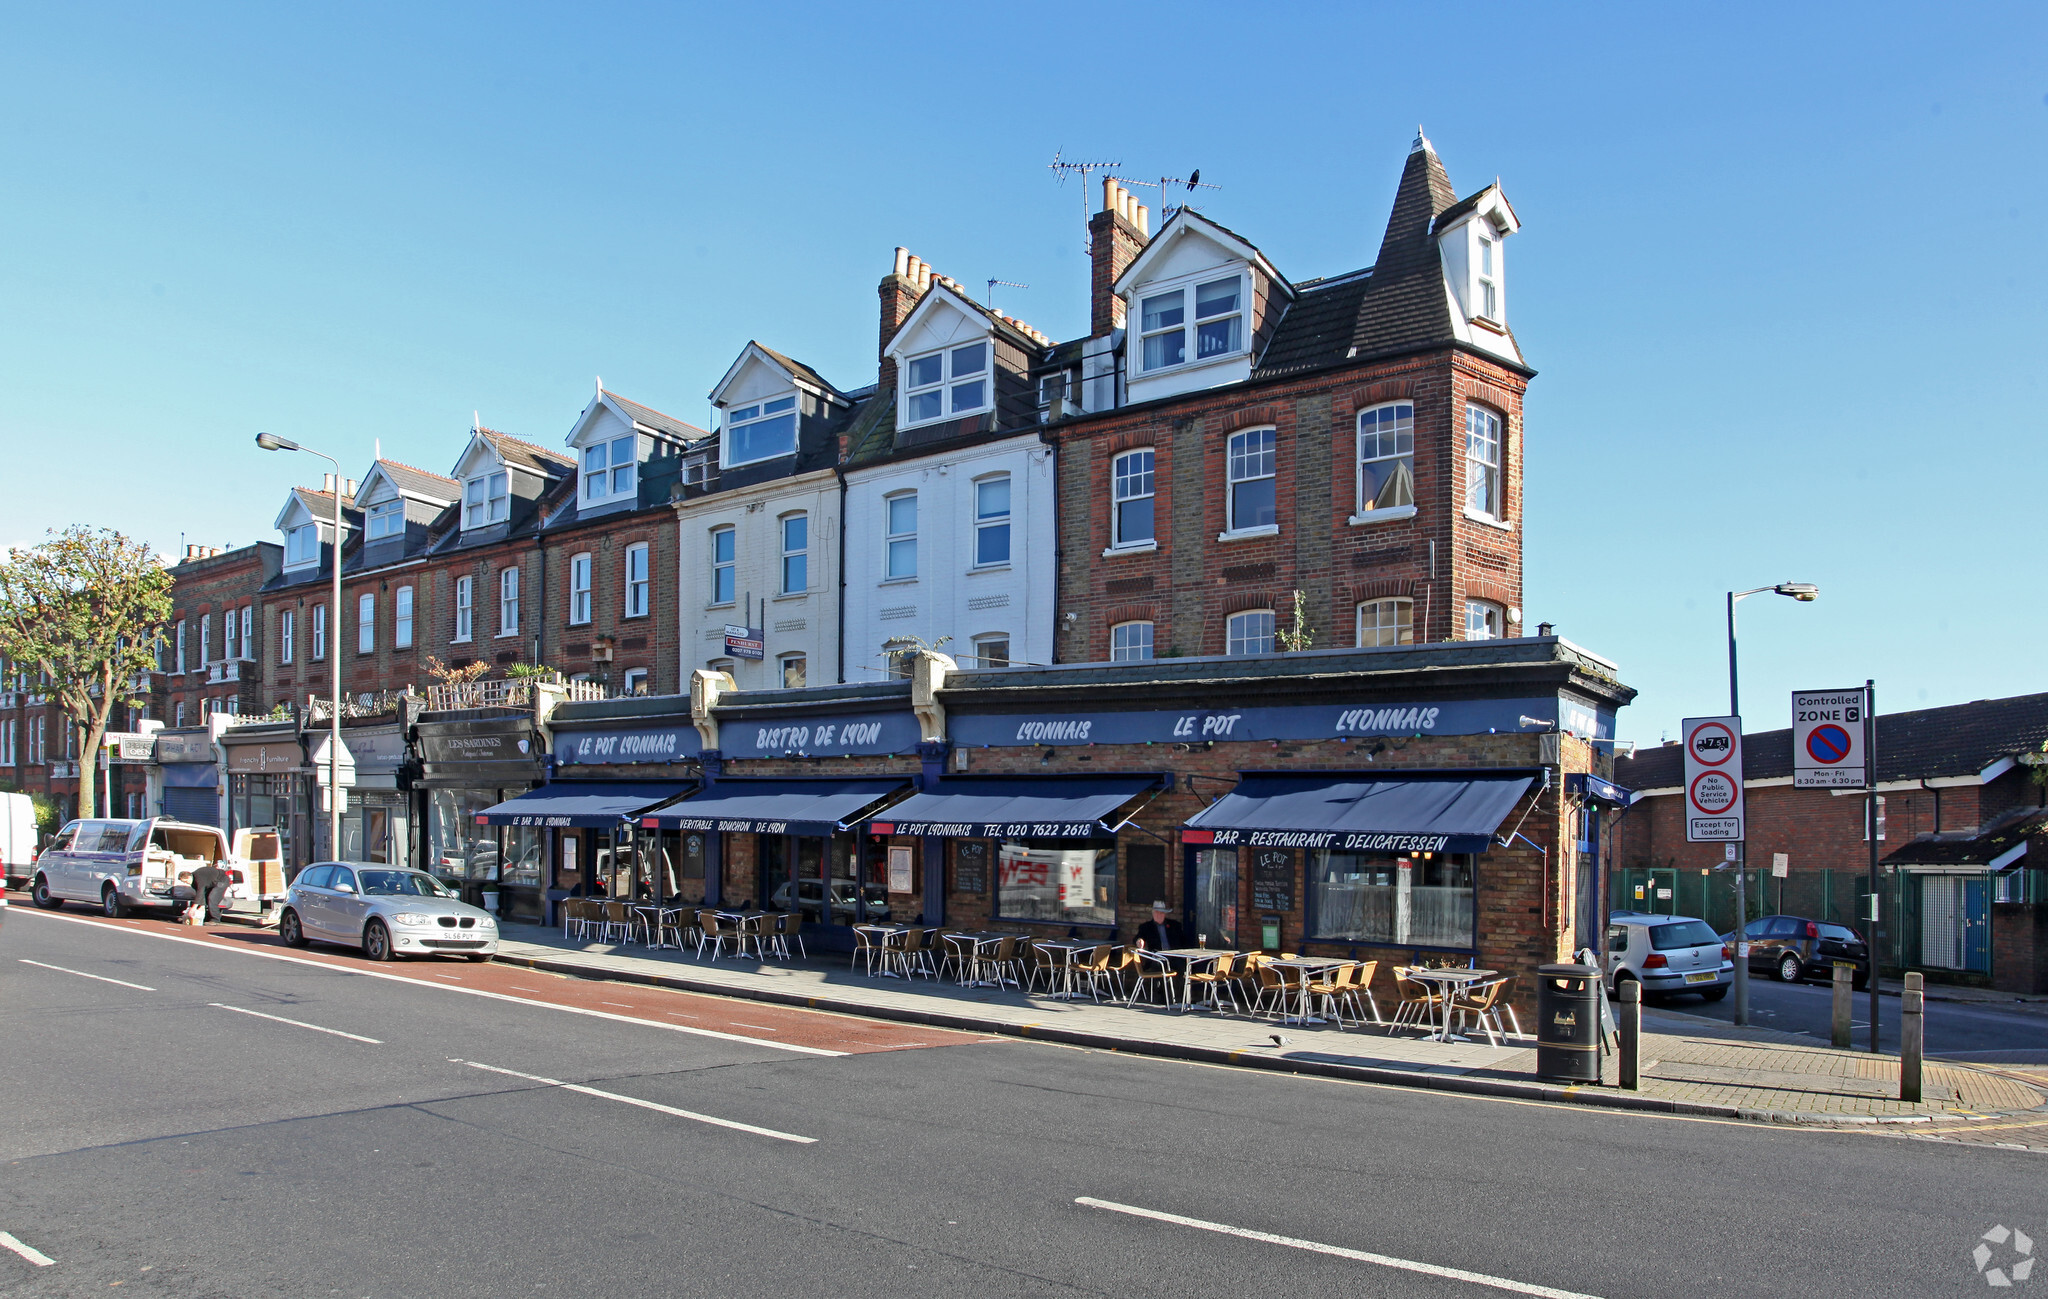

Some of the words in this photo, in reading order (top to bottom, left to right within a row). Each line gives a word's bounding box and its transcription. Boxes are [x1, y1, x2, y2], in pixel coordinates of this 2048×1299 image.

[730, 640, 758, 648] PENHURST
[1798, 695, 1858, 706] Controlled
[1336, 707, 1440, 731] LYONNAIS
[1798, 710, 1840, 721] ZONE
[1846, 709, 1858, 720] C
[1016, 721, 1092, 740] LYONNAIS
[1174, 716, 1196, 736] LE
[1202, 715, 1241, 735] POT
[756, 727, 810, 749] BISTRO
[814, 725, 836, 746] DE
[840, 722, 882, 746] LYON
[448, 739, 463, 749] LES
[464, 738, 501, 748] SARDINES
[578, 738, 592, 755] LE
[595, 736, 618, 755] POT
[620, 734, 677, 754] LYONNAIS
[513, 817, 520, 825] LE
[521, 817, 532, 826] BAR
[534, 817, 543, 826] DU
[546, 817, 571, 826] LYONNAIS
[680, 819, 714, 830] VERITABLE
[718, 821, 752, 832] BOUCHON
[756, 823, 767, 832] DE
[767, 823, 787, 834] LYON
[896, 823, 908, 834] LE
[909, 824, 928, 835] POT
[928, 824, 972, 836] LYONNAIS
[983, 824, 1003, 837] TEL:
[1007, 824, 1028, 836] 020
[1032, 824, 1059, 836] 7622
[1062, 824, 1091, 836] 2618
[1213, 830, 1239, 844] BAR
[1249, 832, 1336, 847] RESTAURANT
[1345, 834, 1448, 851] DELICATESSEN
[1260, 854, 1270, 866] LE
[1273, 852, 1288, 864] POT
